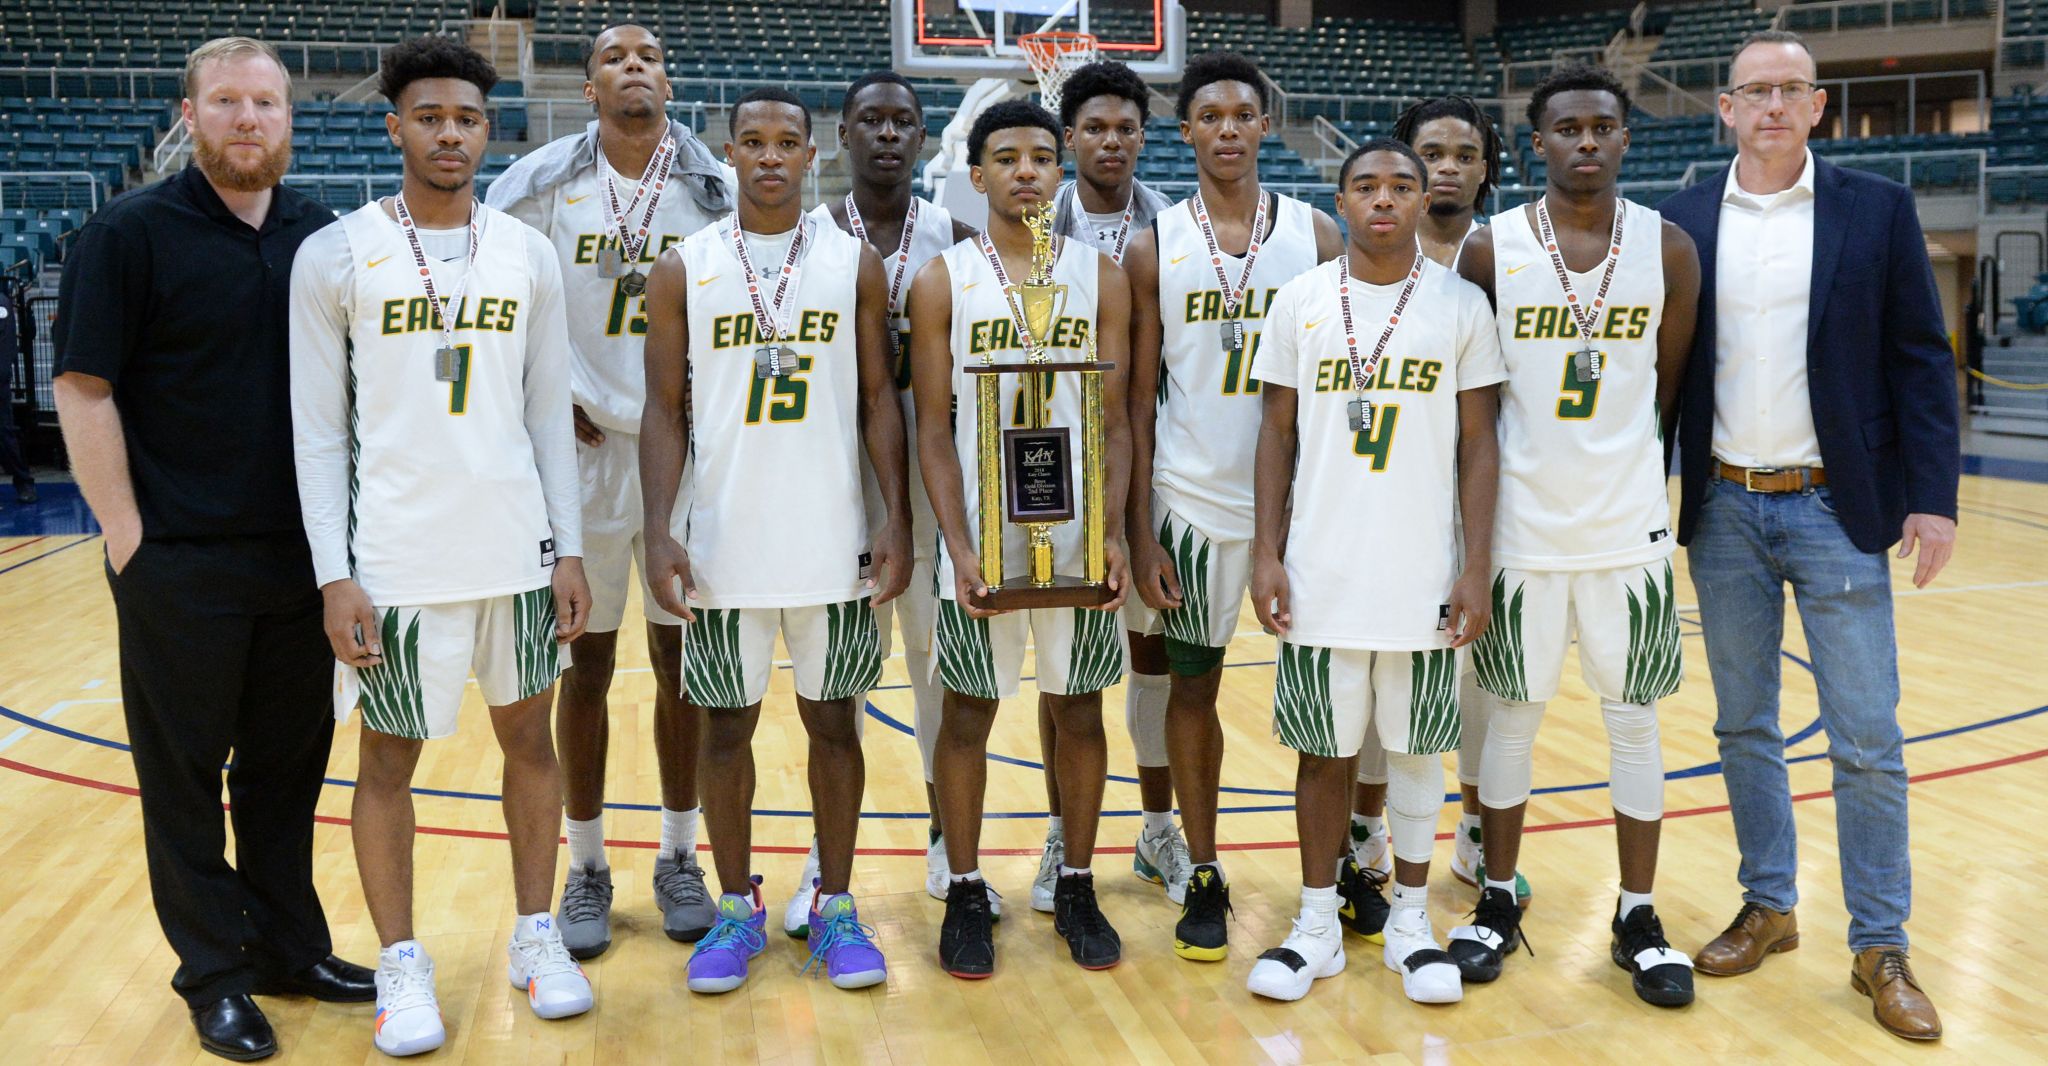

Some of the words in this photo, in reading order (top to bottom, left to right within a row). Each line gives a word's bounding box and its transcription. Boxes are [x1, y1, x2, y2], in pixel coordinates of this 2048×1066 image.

[642, 192, 660, 228] BASKETBALL
[405, 228, 427, 267] BASKETBALL
[988, 253, 1008, 287] BASKETBALL
[1238, 254, 1255, 291] BASKETBALL
[1551, 253, 1573, 292] BASKETBALL
[1598, 258, 1616, 299] BASKETBALL
[1341, 296, 1354, 335] BASKETBALL
[1394, 280, 1415, 316] BASKETBALL
[713, 309, 839, 350] EAES
[969, 317, 1089, 356] EAES
[1233, 323, 1243, 349] HOOPS
[1370, 326, 1394, 365] BASKETBALL
[448, 343, 474, 417] 1
[769, 348, 780, 376] HOOPS
[1589, 351, 1600, 380] HOOPS
[744, 354, 814, 426] 15
[1361, 401, 1371, 429] HOOPS
[1352, 403, 1401, 473] 4
